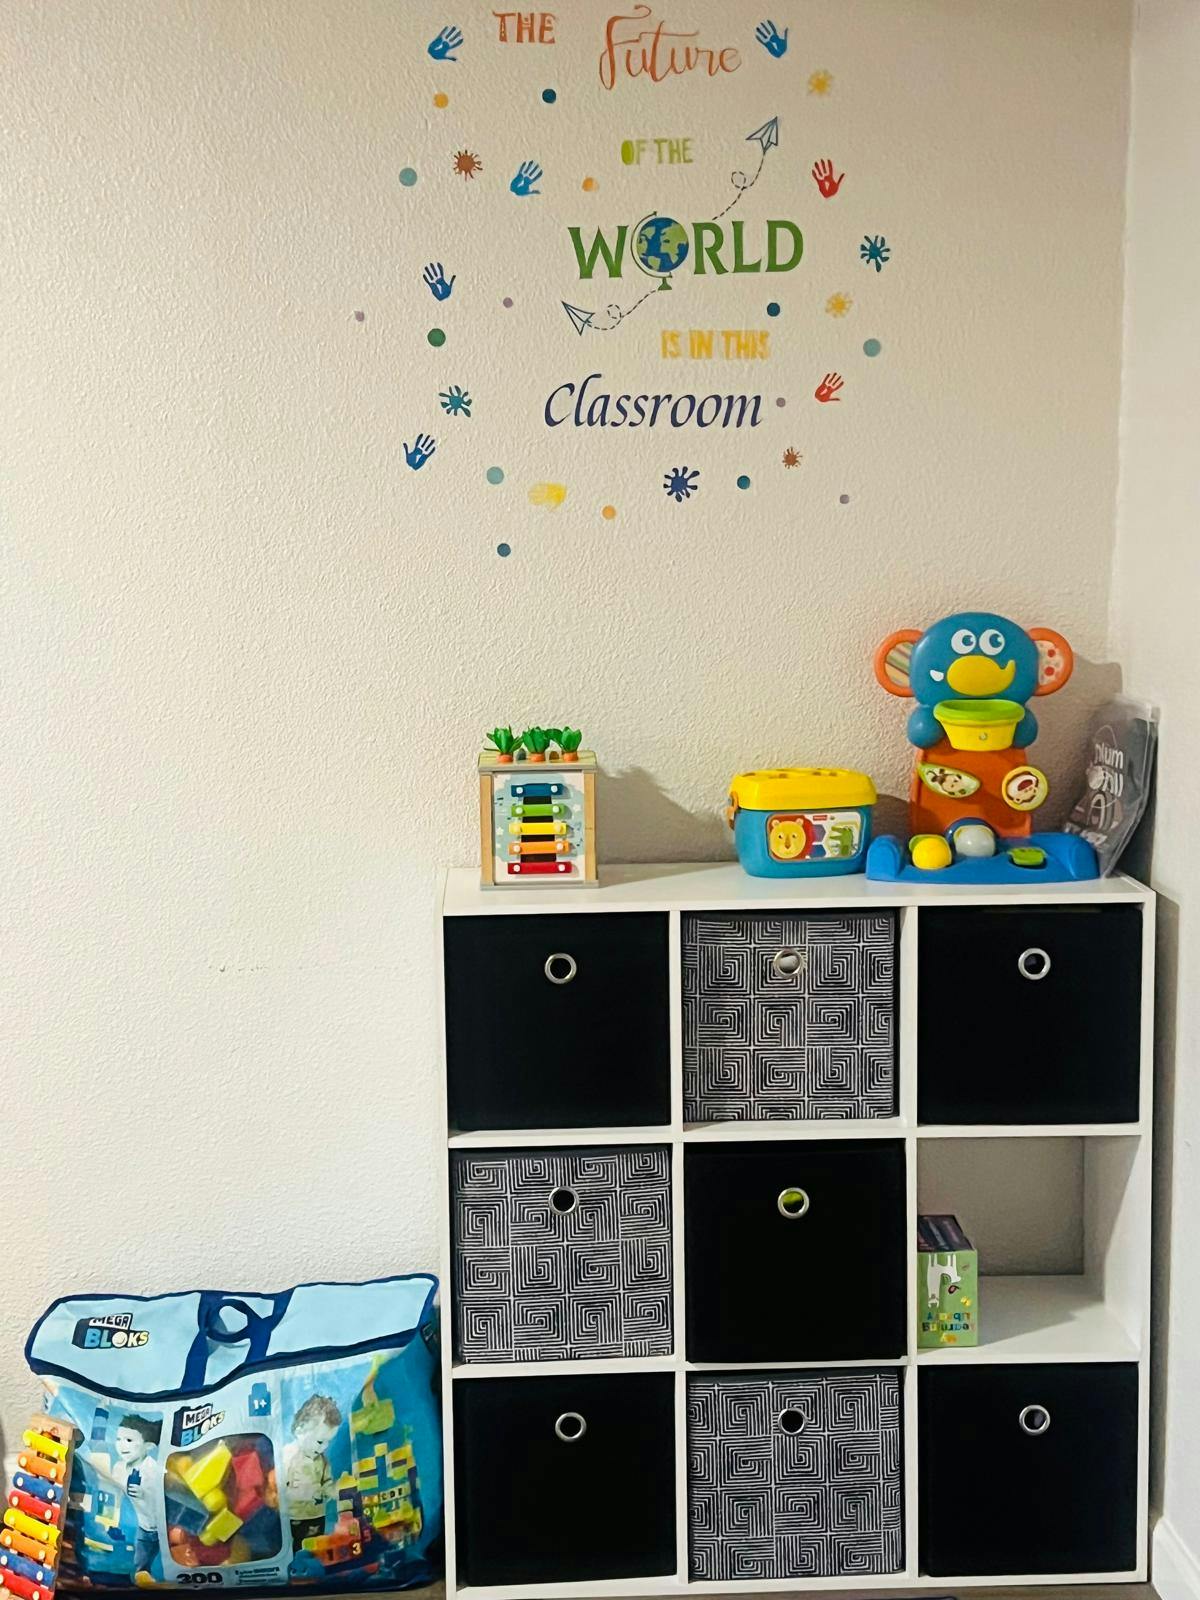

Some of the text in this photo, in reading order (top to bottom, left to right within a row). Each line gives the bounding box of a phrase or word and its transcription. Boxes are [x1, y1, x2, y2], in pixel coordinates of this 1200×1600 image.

[492, 5, 742, 90] THE Future
[621, 137, 694, 165] OF THE
[567, 212, 804, 288] WORLD
[661, 329, 769, 360] IS IN THIS
[544, 373, 763, 428] Classroom
[93, 1315, 129, 1328] MEGA
[84, 1328, 149, 1348] BLOKS
[186, 1407, 210, 1426] MEGA
[253, 1399, 267, 1410] 1+
[181, 1411, 225, 1447] BLOKS
